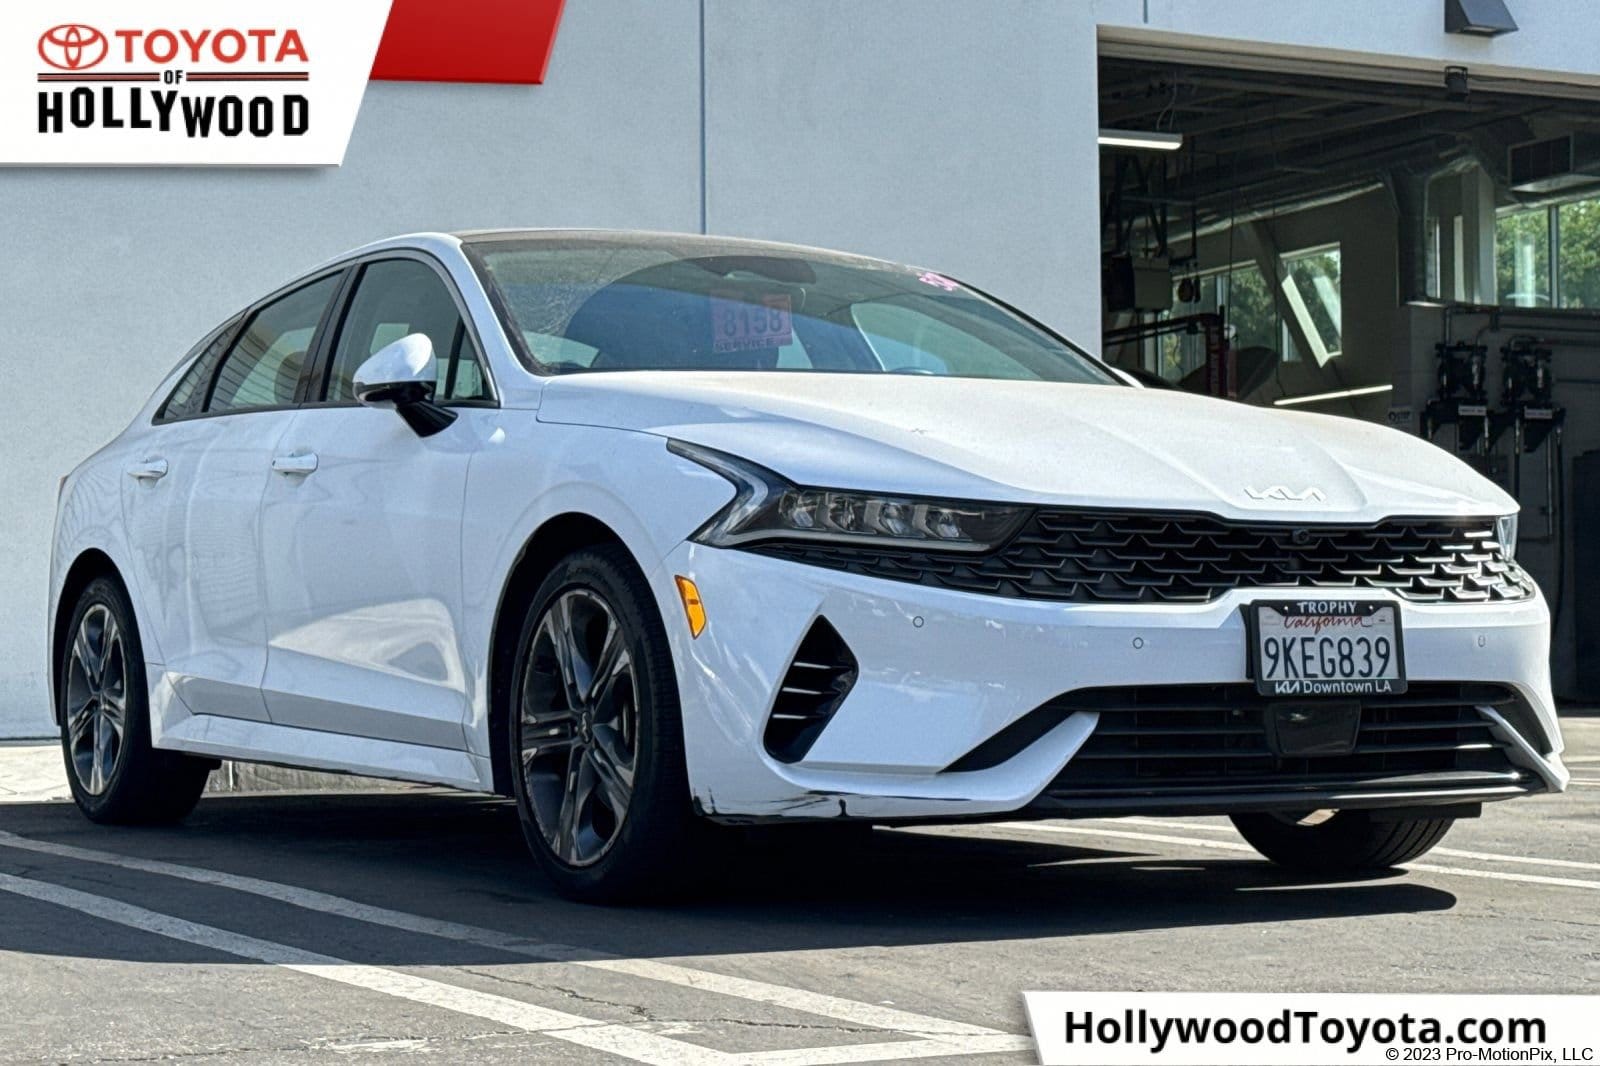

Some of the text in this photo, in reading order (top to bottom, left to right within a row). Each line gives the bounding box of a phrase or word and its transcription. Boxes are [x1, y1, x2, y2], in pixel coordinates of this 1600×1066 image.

[1243, 486, 1327, 502] KIA
[1297, 601, 1357, 614] TROPHY
[1284, 615, 1372, 635] California
[1264, 636, 1391, 679] 9KEG839
[1303, 680, 1372, 693] Downtown
[1376, 680, 1392, 692] LA
